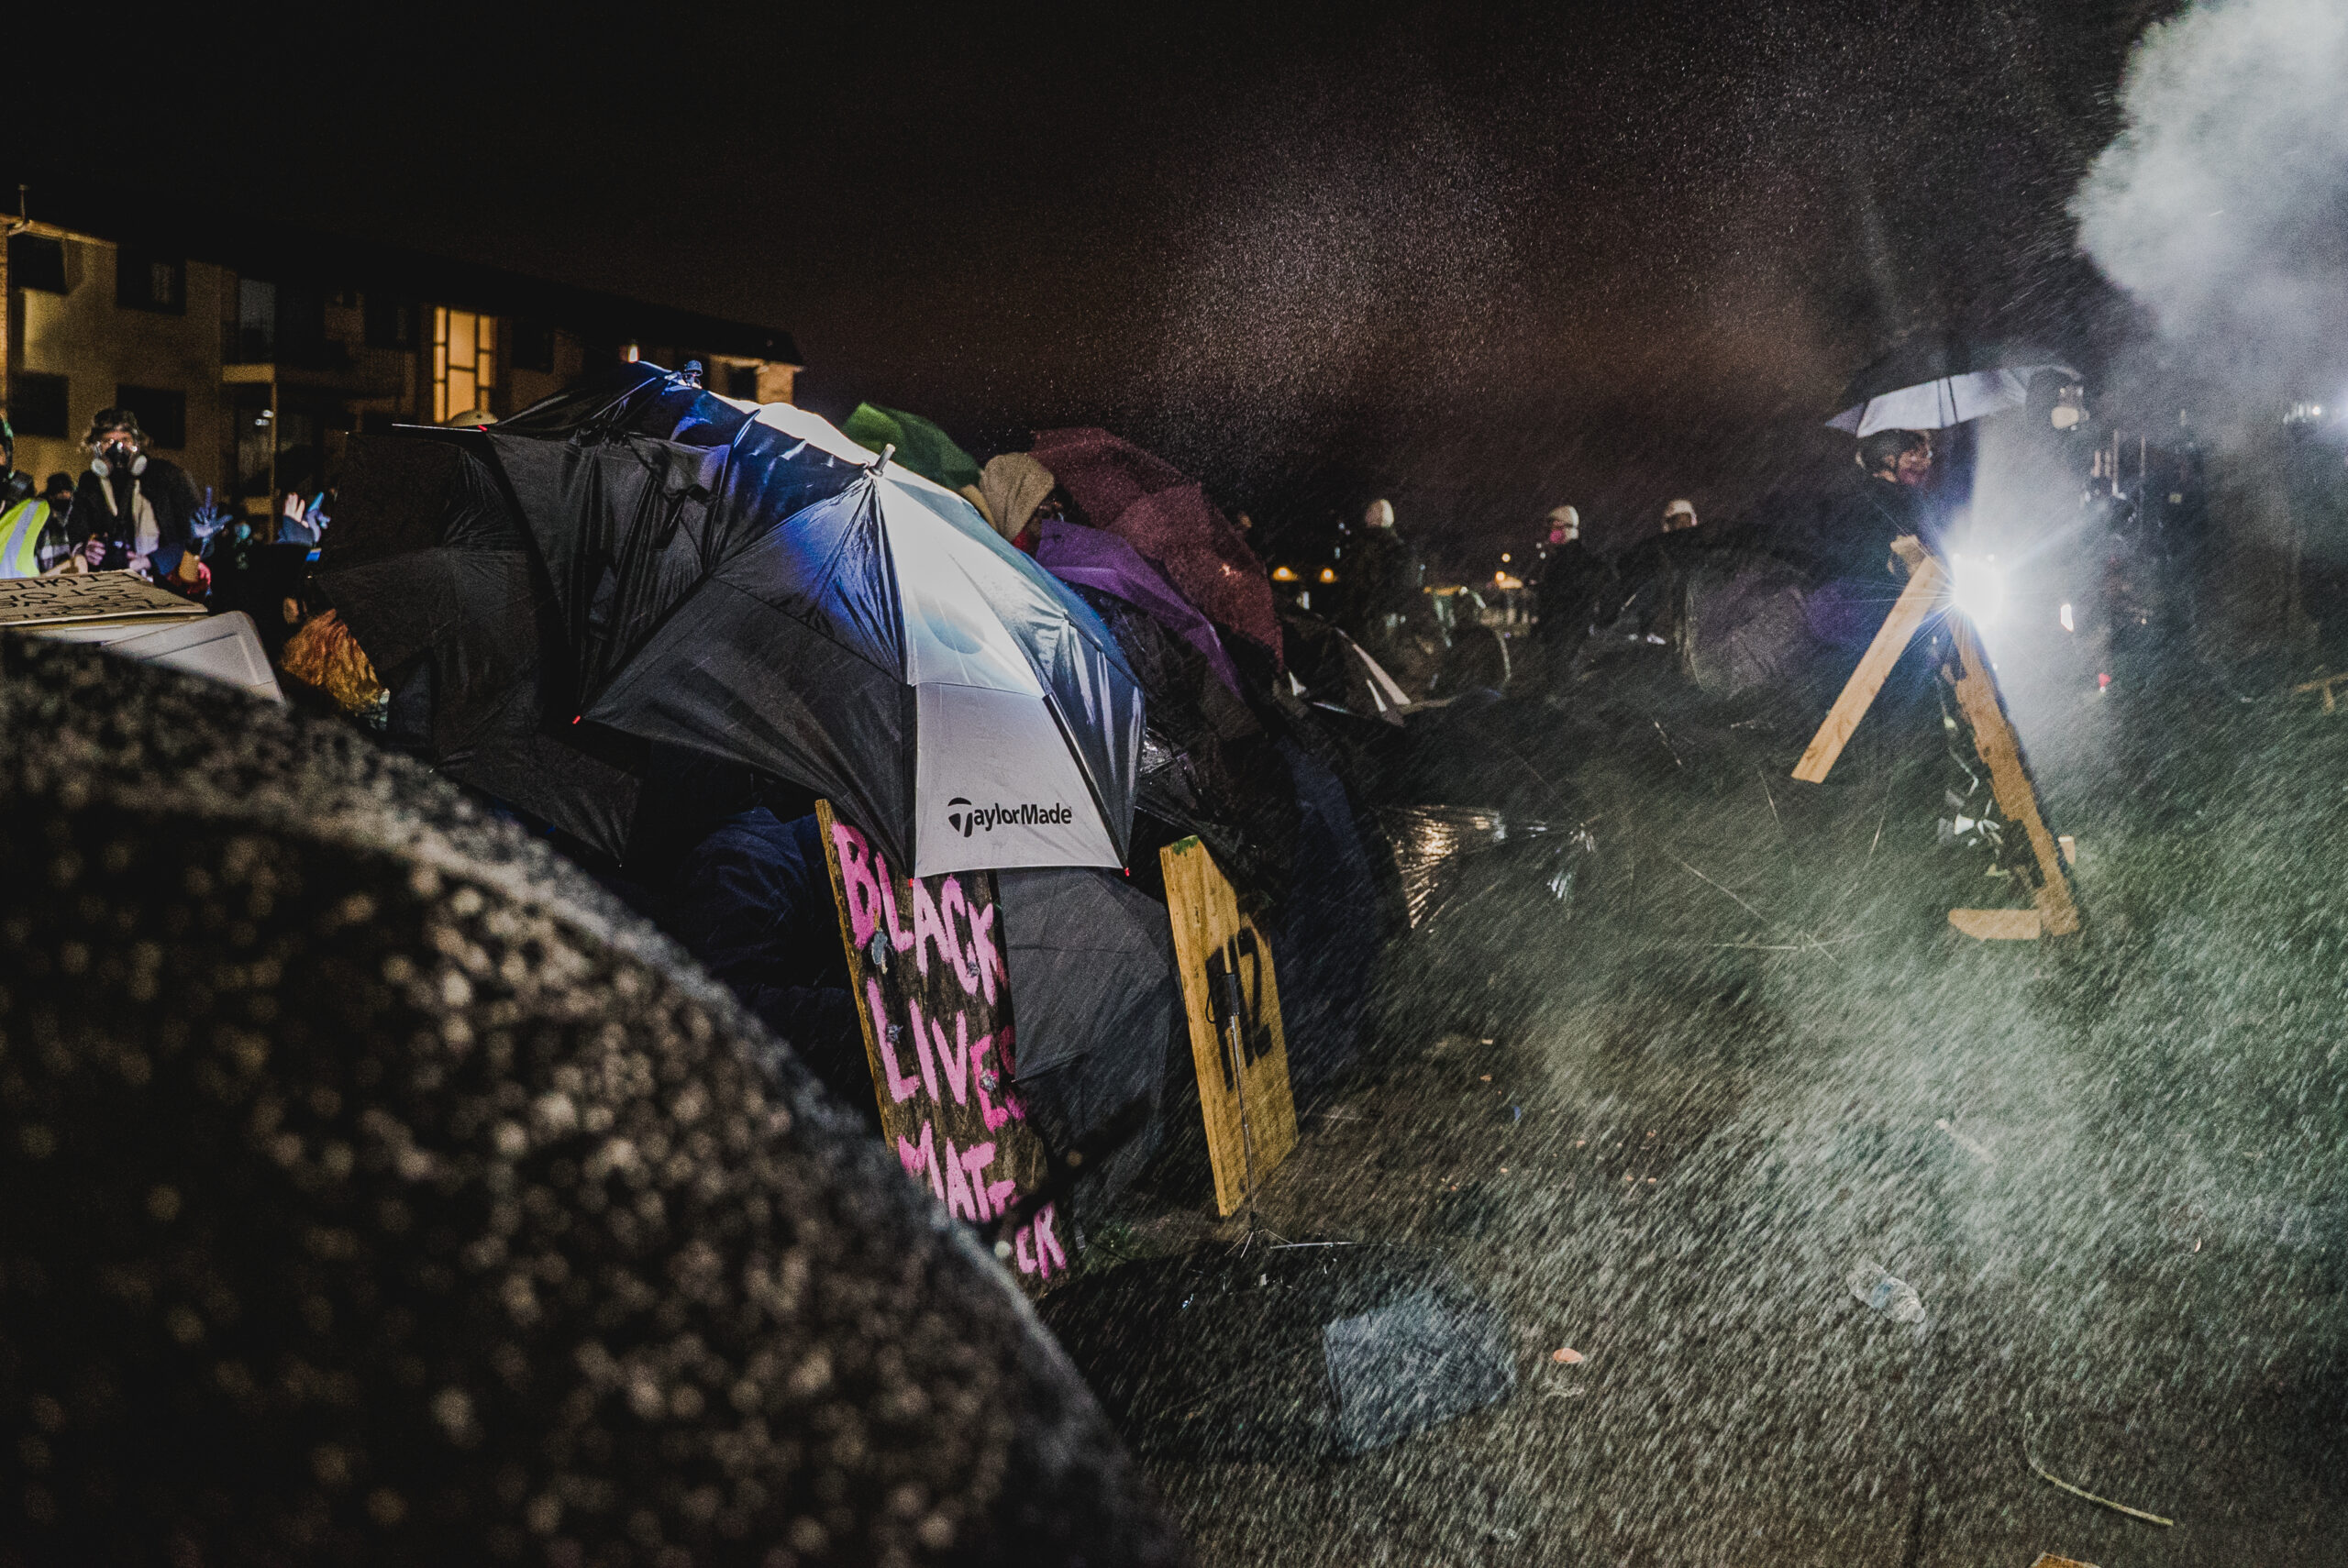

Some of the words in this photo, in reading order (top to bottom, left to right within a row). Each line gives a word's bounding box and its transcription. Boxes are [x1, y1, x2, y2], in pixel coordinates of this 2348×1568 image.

[947, 797, 1072, 837] TaylorMade
[831, 820, 1009, 1007] BLACK
[867, 977, 1027, 1134] LIVES
